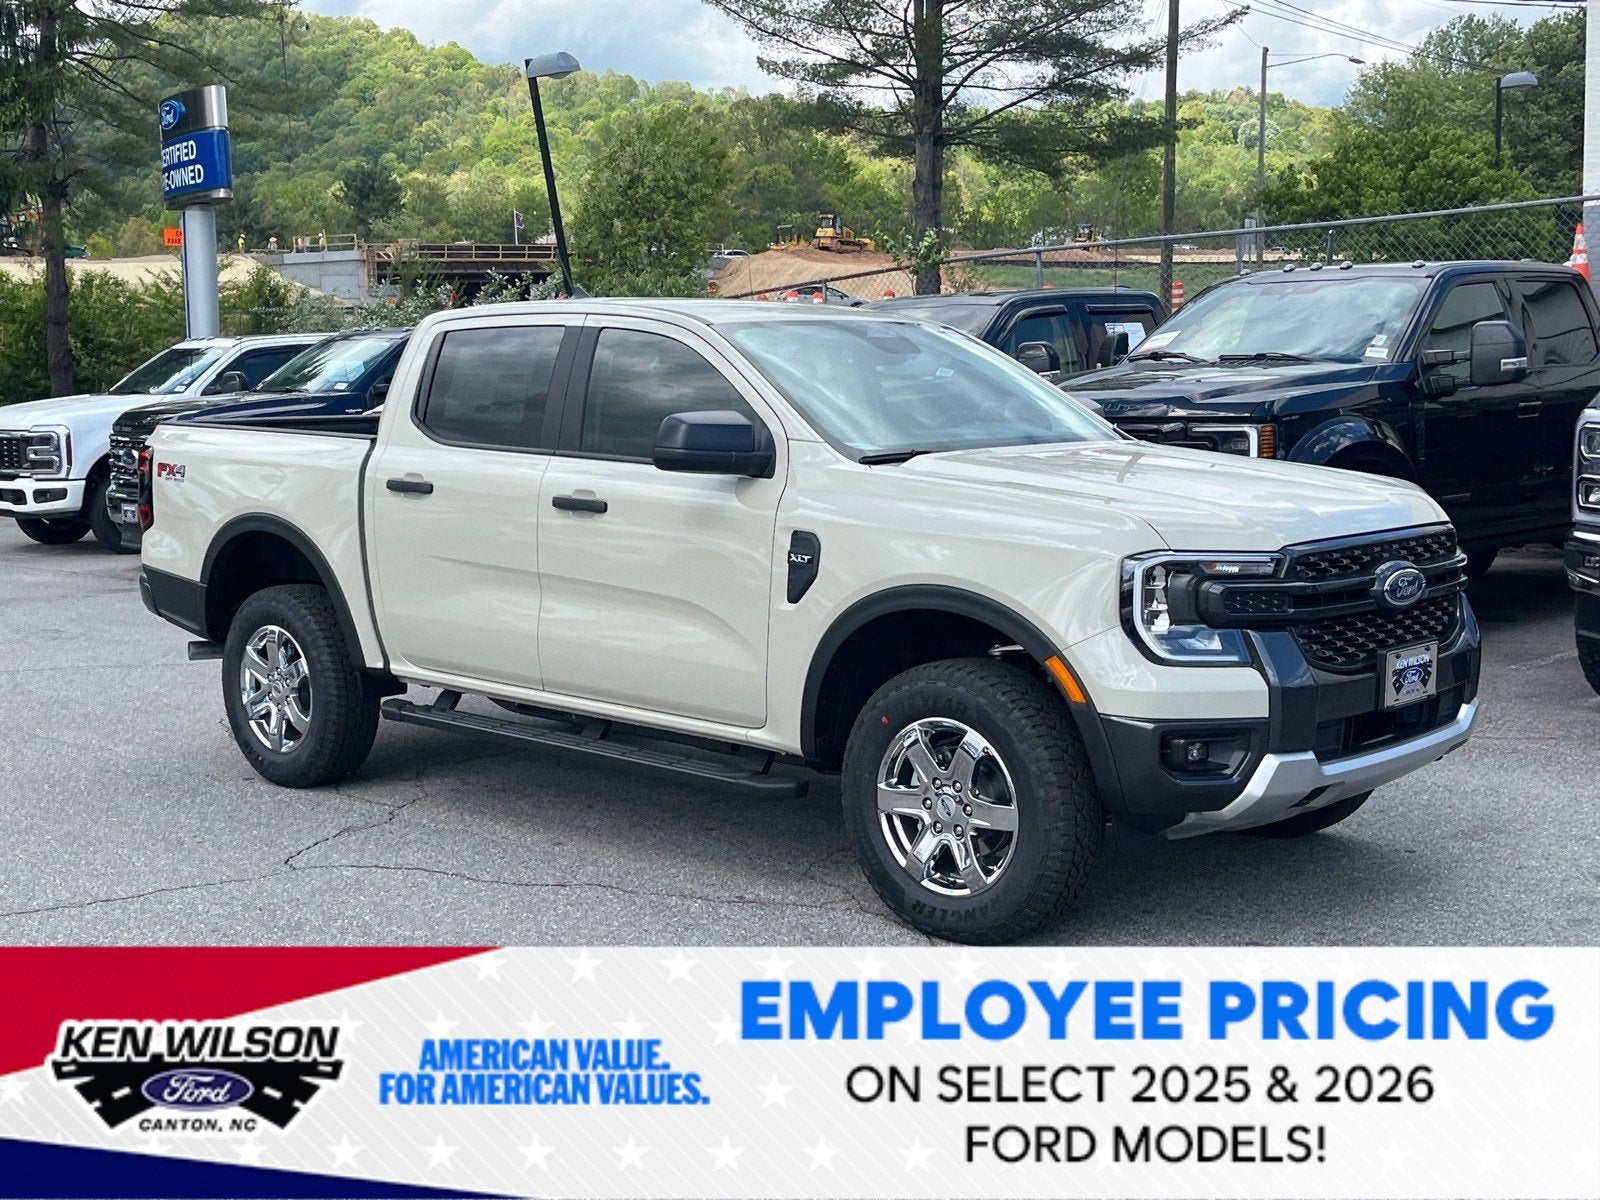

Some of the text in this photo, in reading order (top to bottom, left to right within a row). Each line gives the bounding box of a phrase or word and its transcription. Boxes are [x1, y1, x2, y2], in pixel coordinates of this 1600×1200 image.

[161, 139, 197, 168] ERTIFIED
[164, 163, 204, 192] E-OWNED
[157, 462, 186, 478] FX4
[790, 553, 812, 563] XLT
